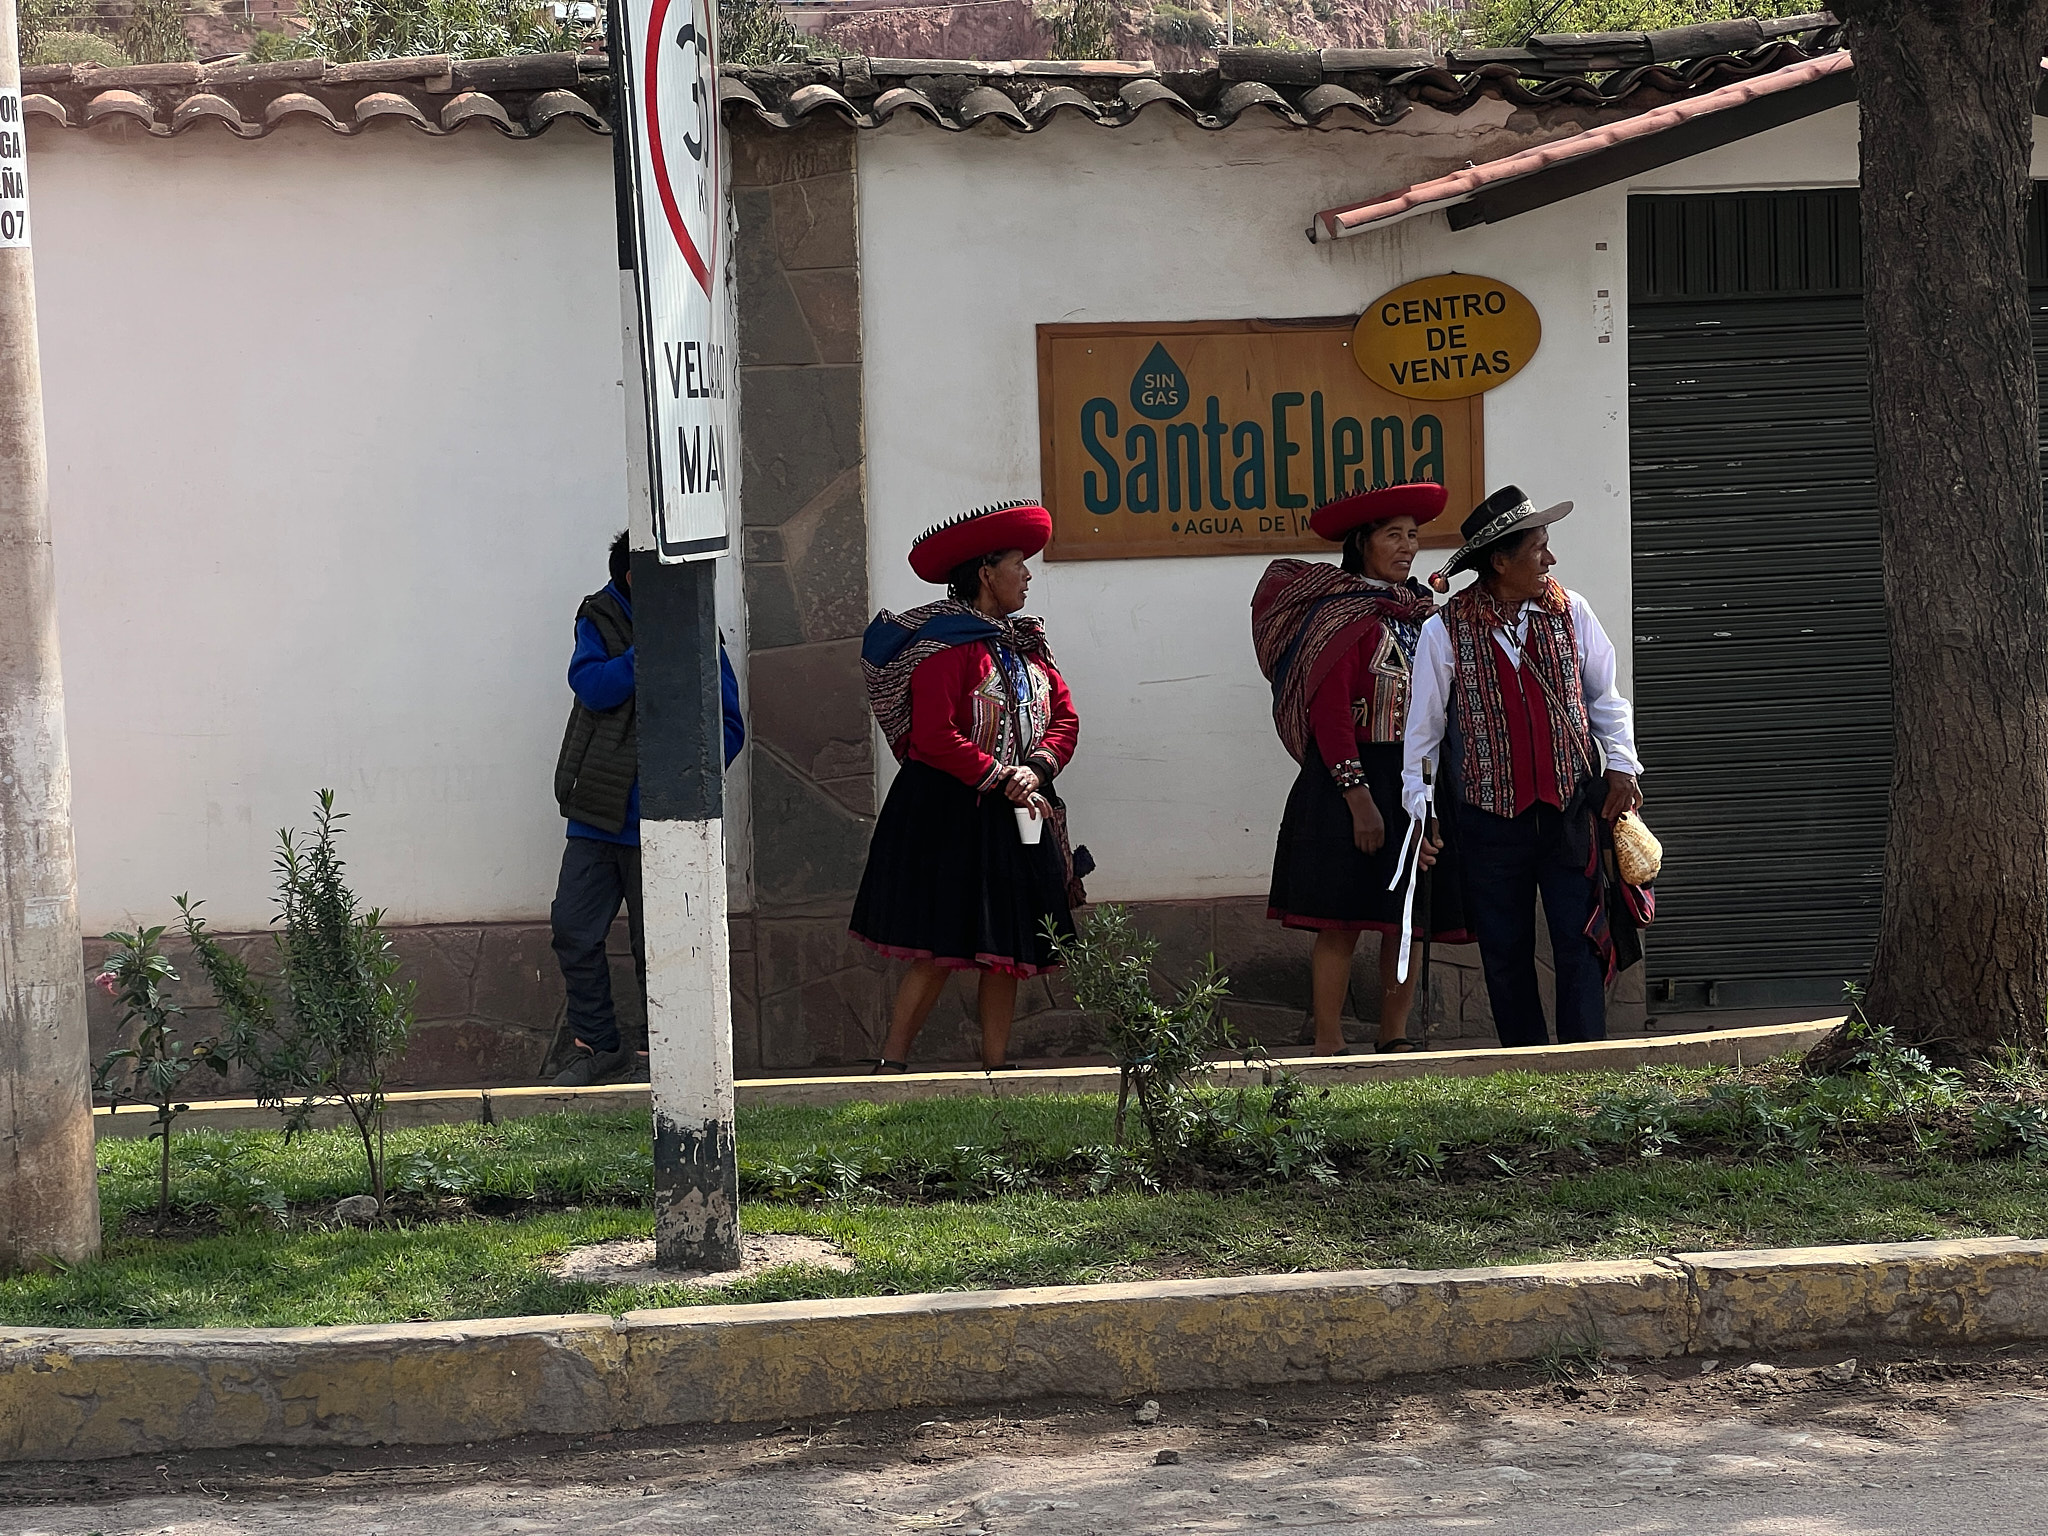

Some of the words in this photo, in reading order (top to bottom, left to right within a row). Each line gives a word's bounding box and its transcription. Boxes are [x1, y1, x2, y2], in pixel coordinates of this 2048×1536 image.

[0, 166, 24, 199] ÑA
[1381, 290, 1507, 327] CENTRO
[1426, 324, 1467, 352] DE
[1389, 349, 1511, 385] VENTAS
[1144, 373, 1176, 390] SIN
[1141, 390, 1179, 407] GAS
[1184, 517, 1244, 535] AGUA
[1258, 515, 1286, 532] DE
